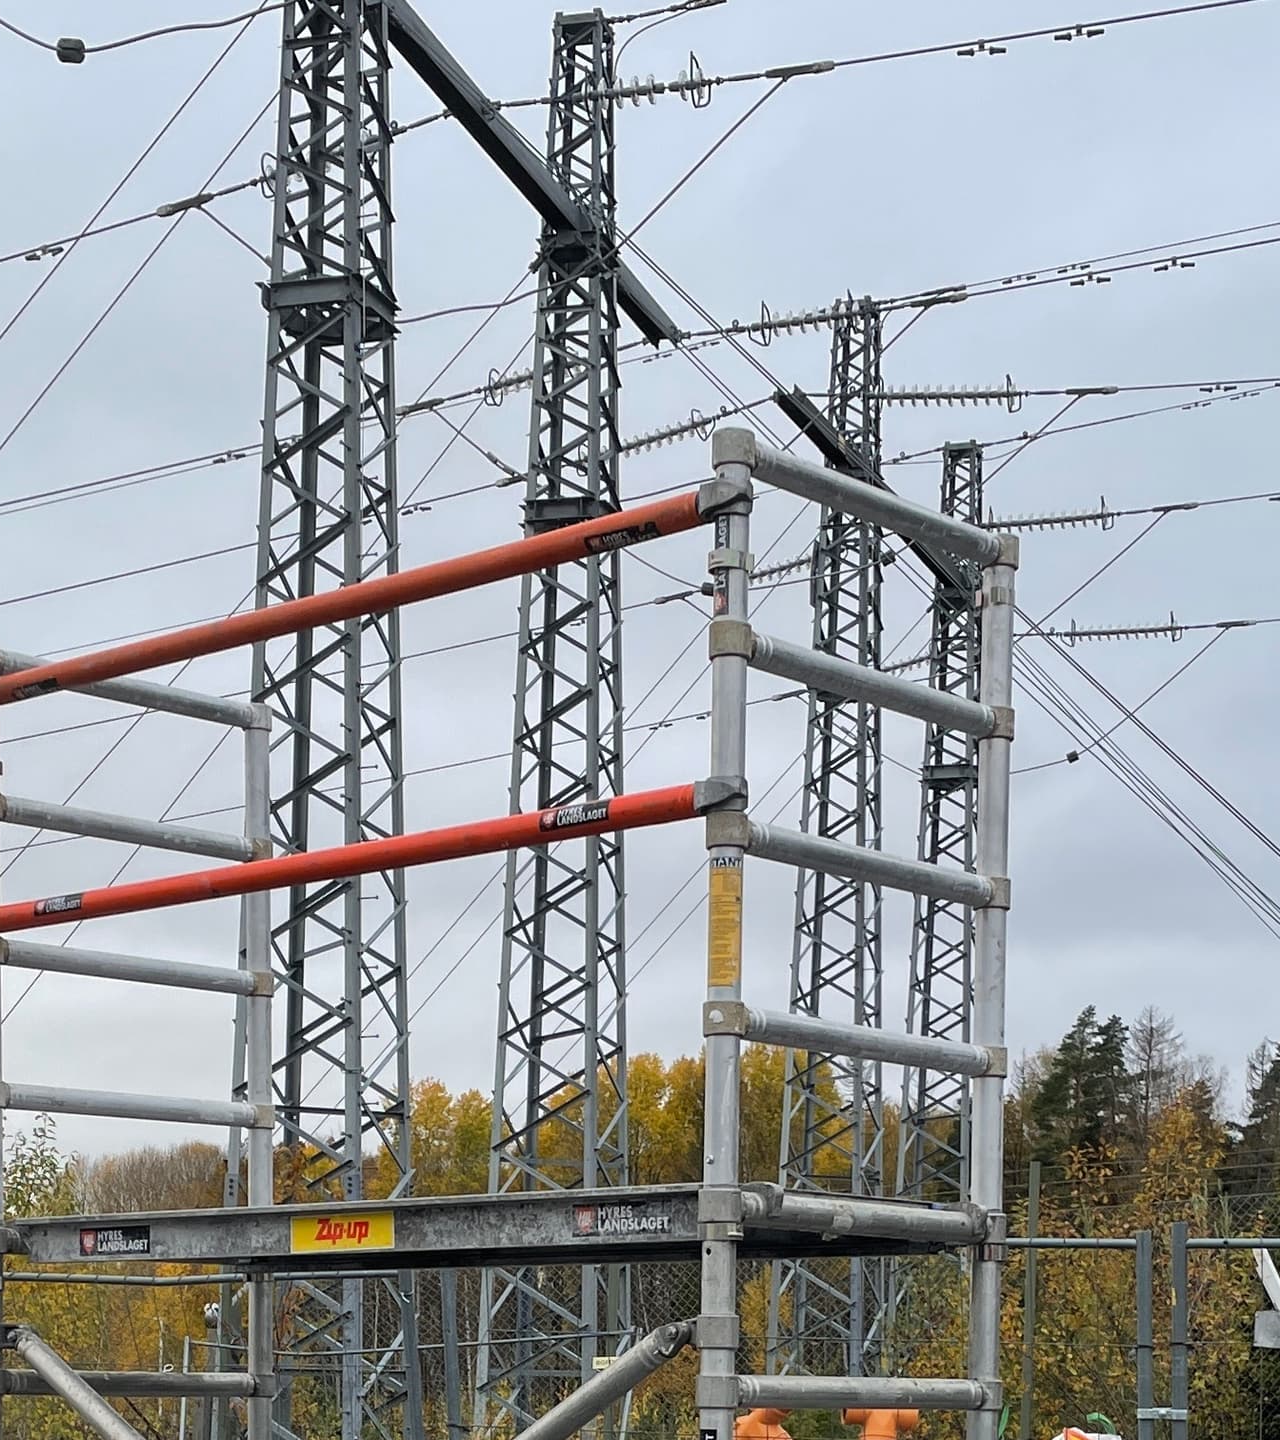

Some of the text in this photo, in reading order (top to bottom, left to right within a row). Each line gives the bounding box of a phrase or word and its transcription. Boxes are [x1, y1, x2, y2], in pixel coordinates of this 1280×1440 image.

[718, 515, 728, 589] LALAGET
[597, 1205, 633, 1219] HYRES
[597, 1216, 670, 1232] LANDSLAGET
[97, 1230, 123, 1241] HYRES
[97, 1239, 149, 1251] LANDSLAGET
